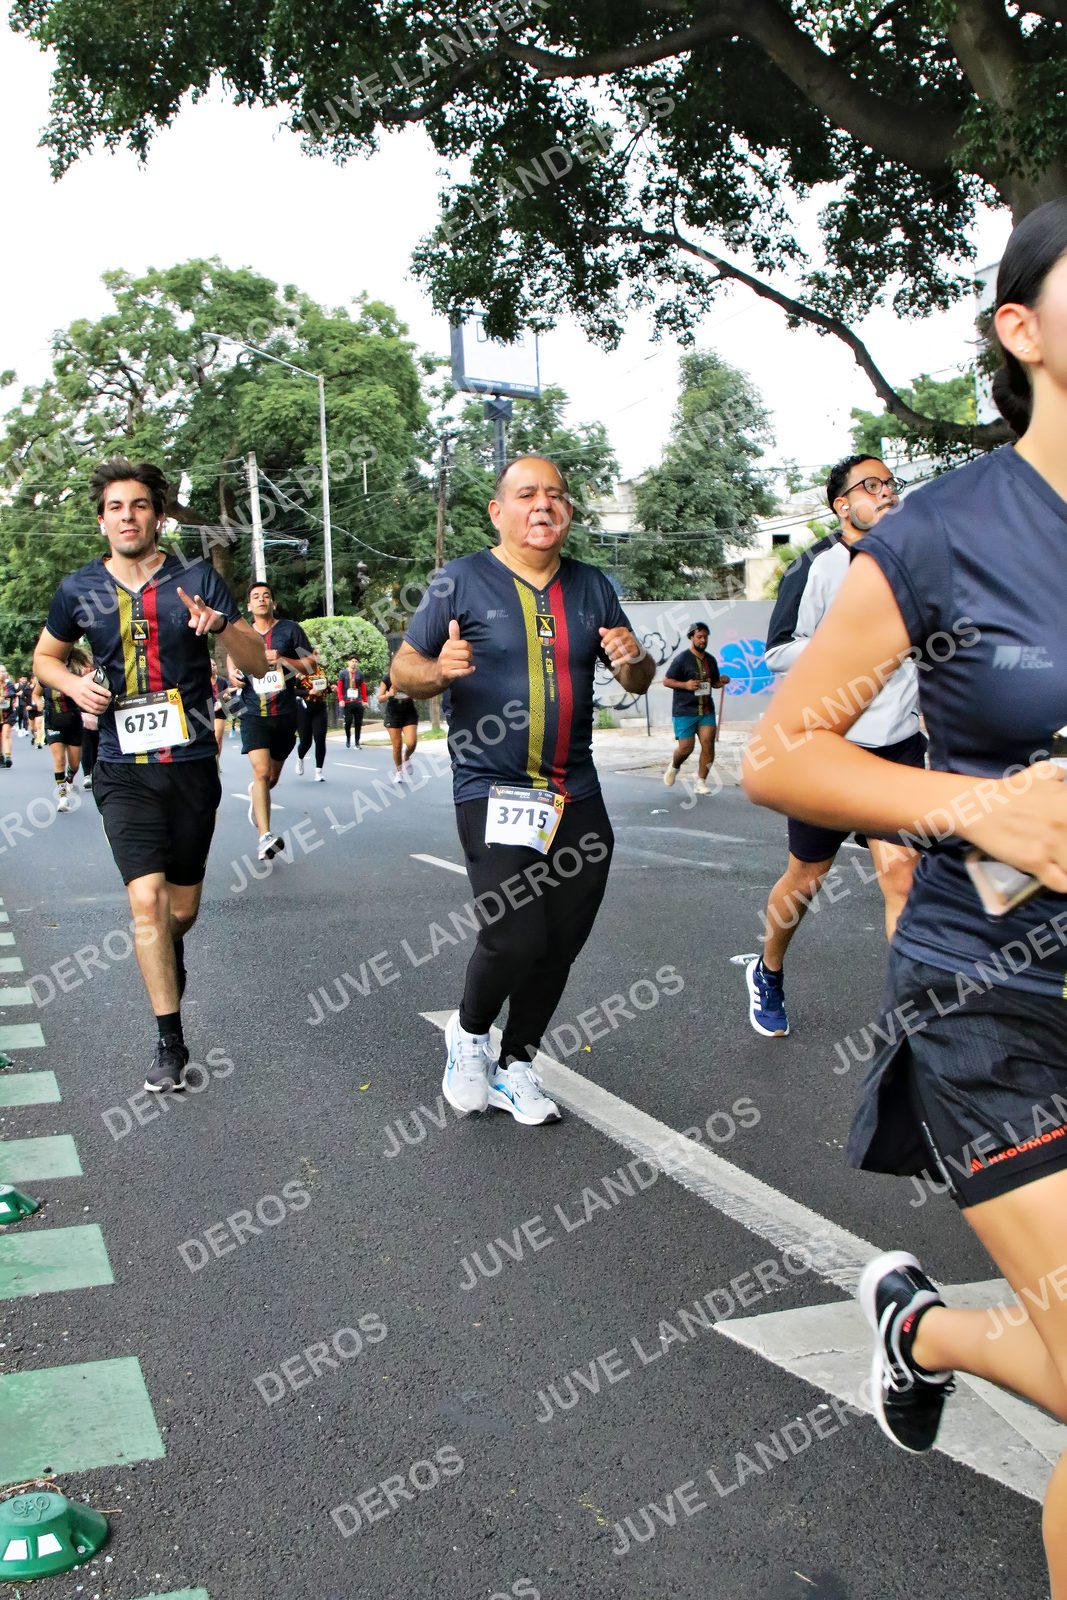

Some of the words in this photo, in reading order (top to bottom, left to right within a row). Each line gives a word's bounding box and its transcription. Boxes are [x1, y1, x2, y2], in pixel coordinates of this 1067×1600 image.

[170, 692, 178, 701] 5K
[124, 709, 168, 733] 6737
[555, 800, 563, 808] 5K
[497, 806, 548, 829] 3715
